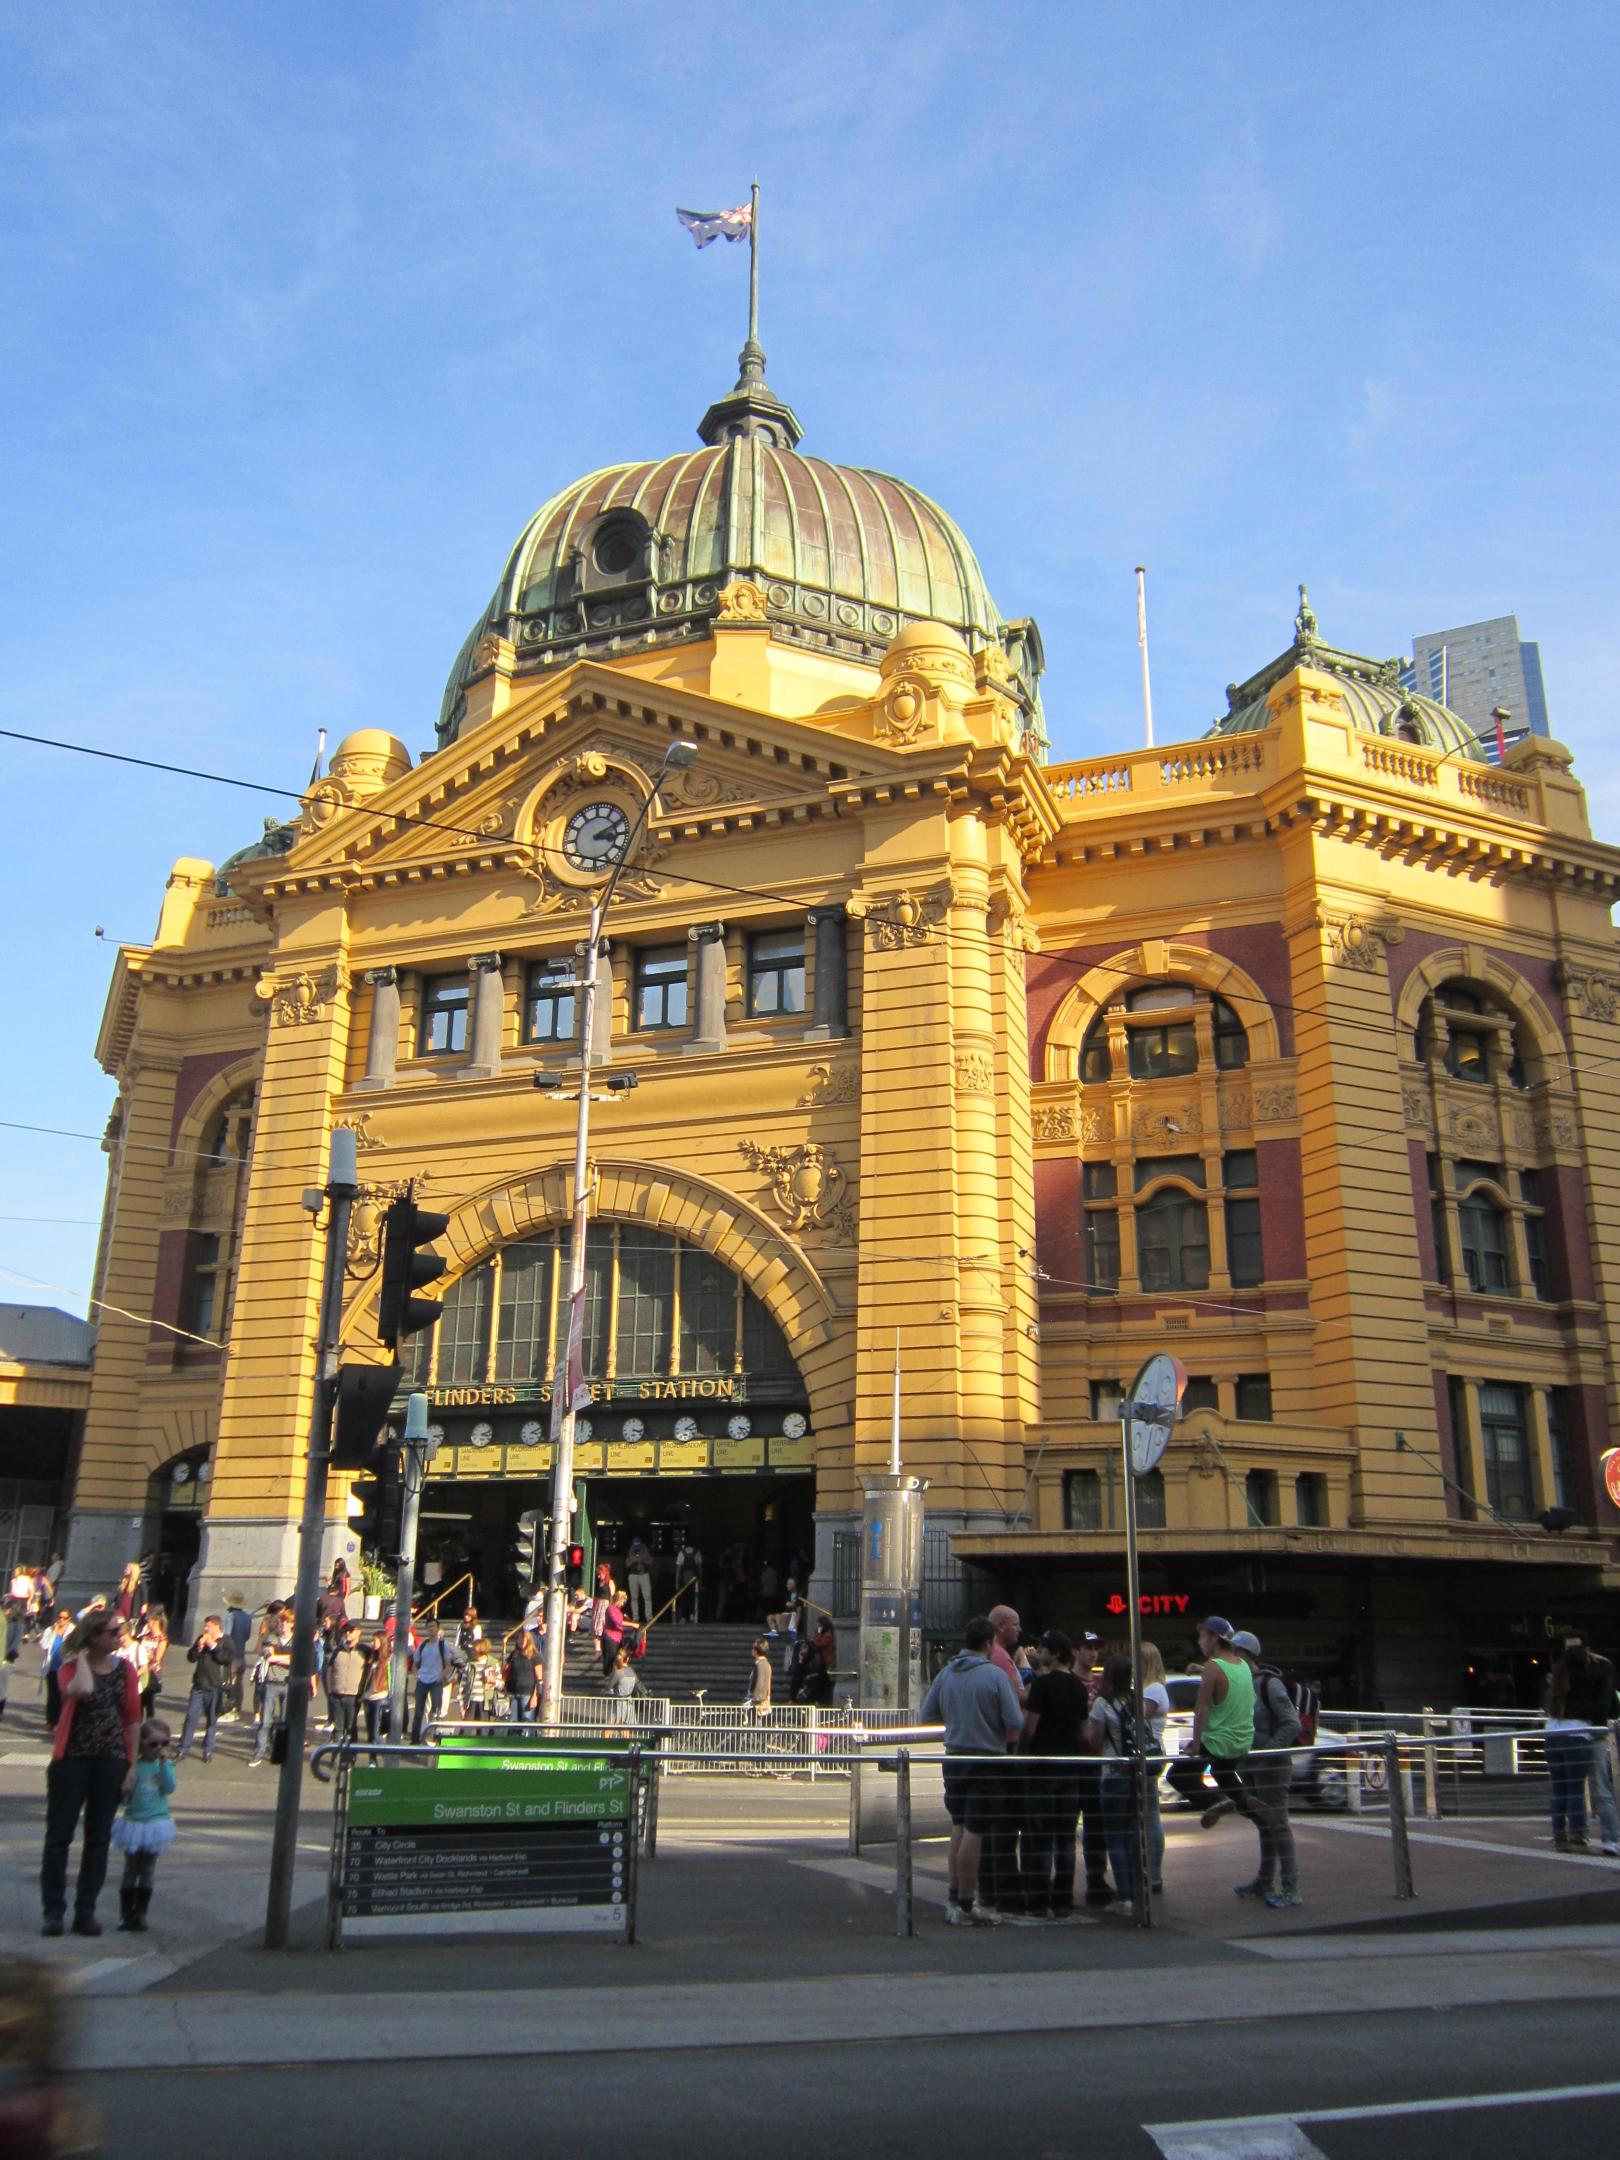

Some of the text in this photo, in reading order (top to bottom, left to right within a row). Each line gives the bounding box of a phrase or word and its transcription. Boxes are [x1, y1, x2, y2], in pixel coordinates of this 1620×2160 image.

[424, 1386, 516, 1406] FLINDERS
[541, 1384, 615, 1402] SET
[639, 1379, 734, 1400] STATION
[1138, 1595, 1190, 1613] CITY
[434, 1799, 623, 1818] Swanston St and Flinders St
[375, 1841, 391, 1851] City
[393, 1840, 416, 1849] Circle
[350, 1857, 360, 1867] 70
[418, 1855, 434, 1865] City
[613, 1908, 621, 1921] 5
